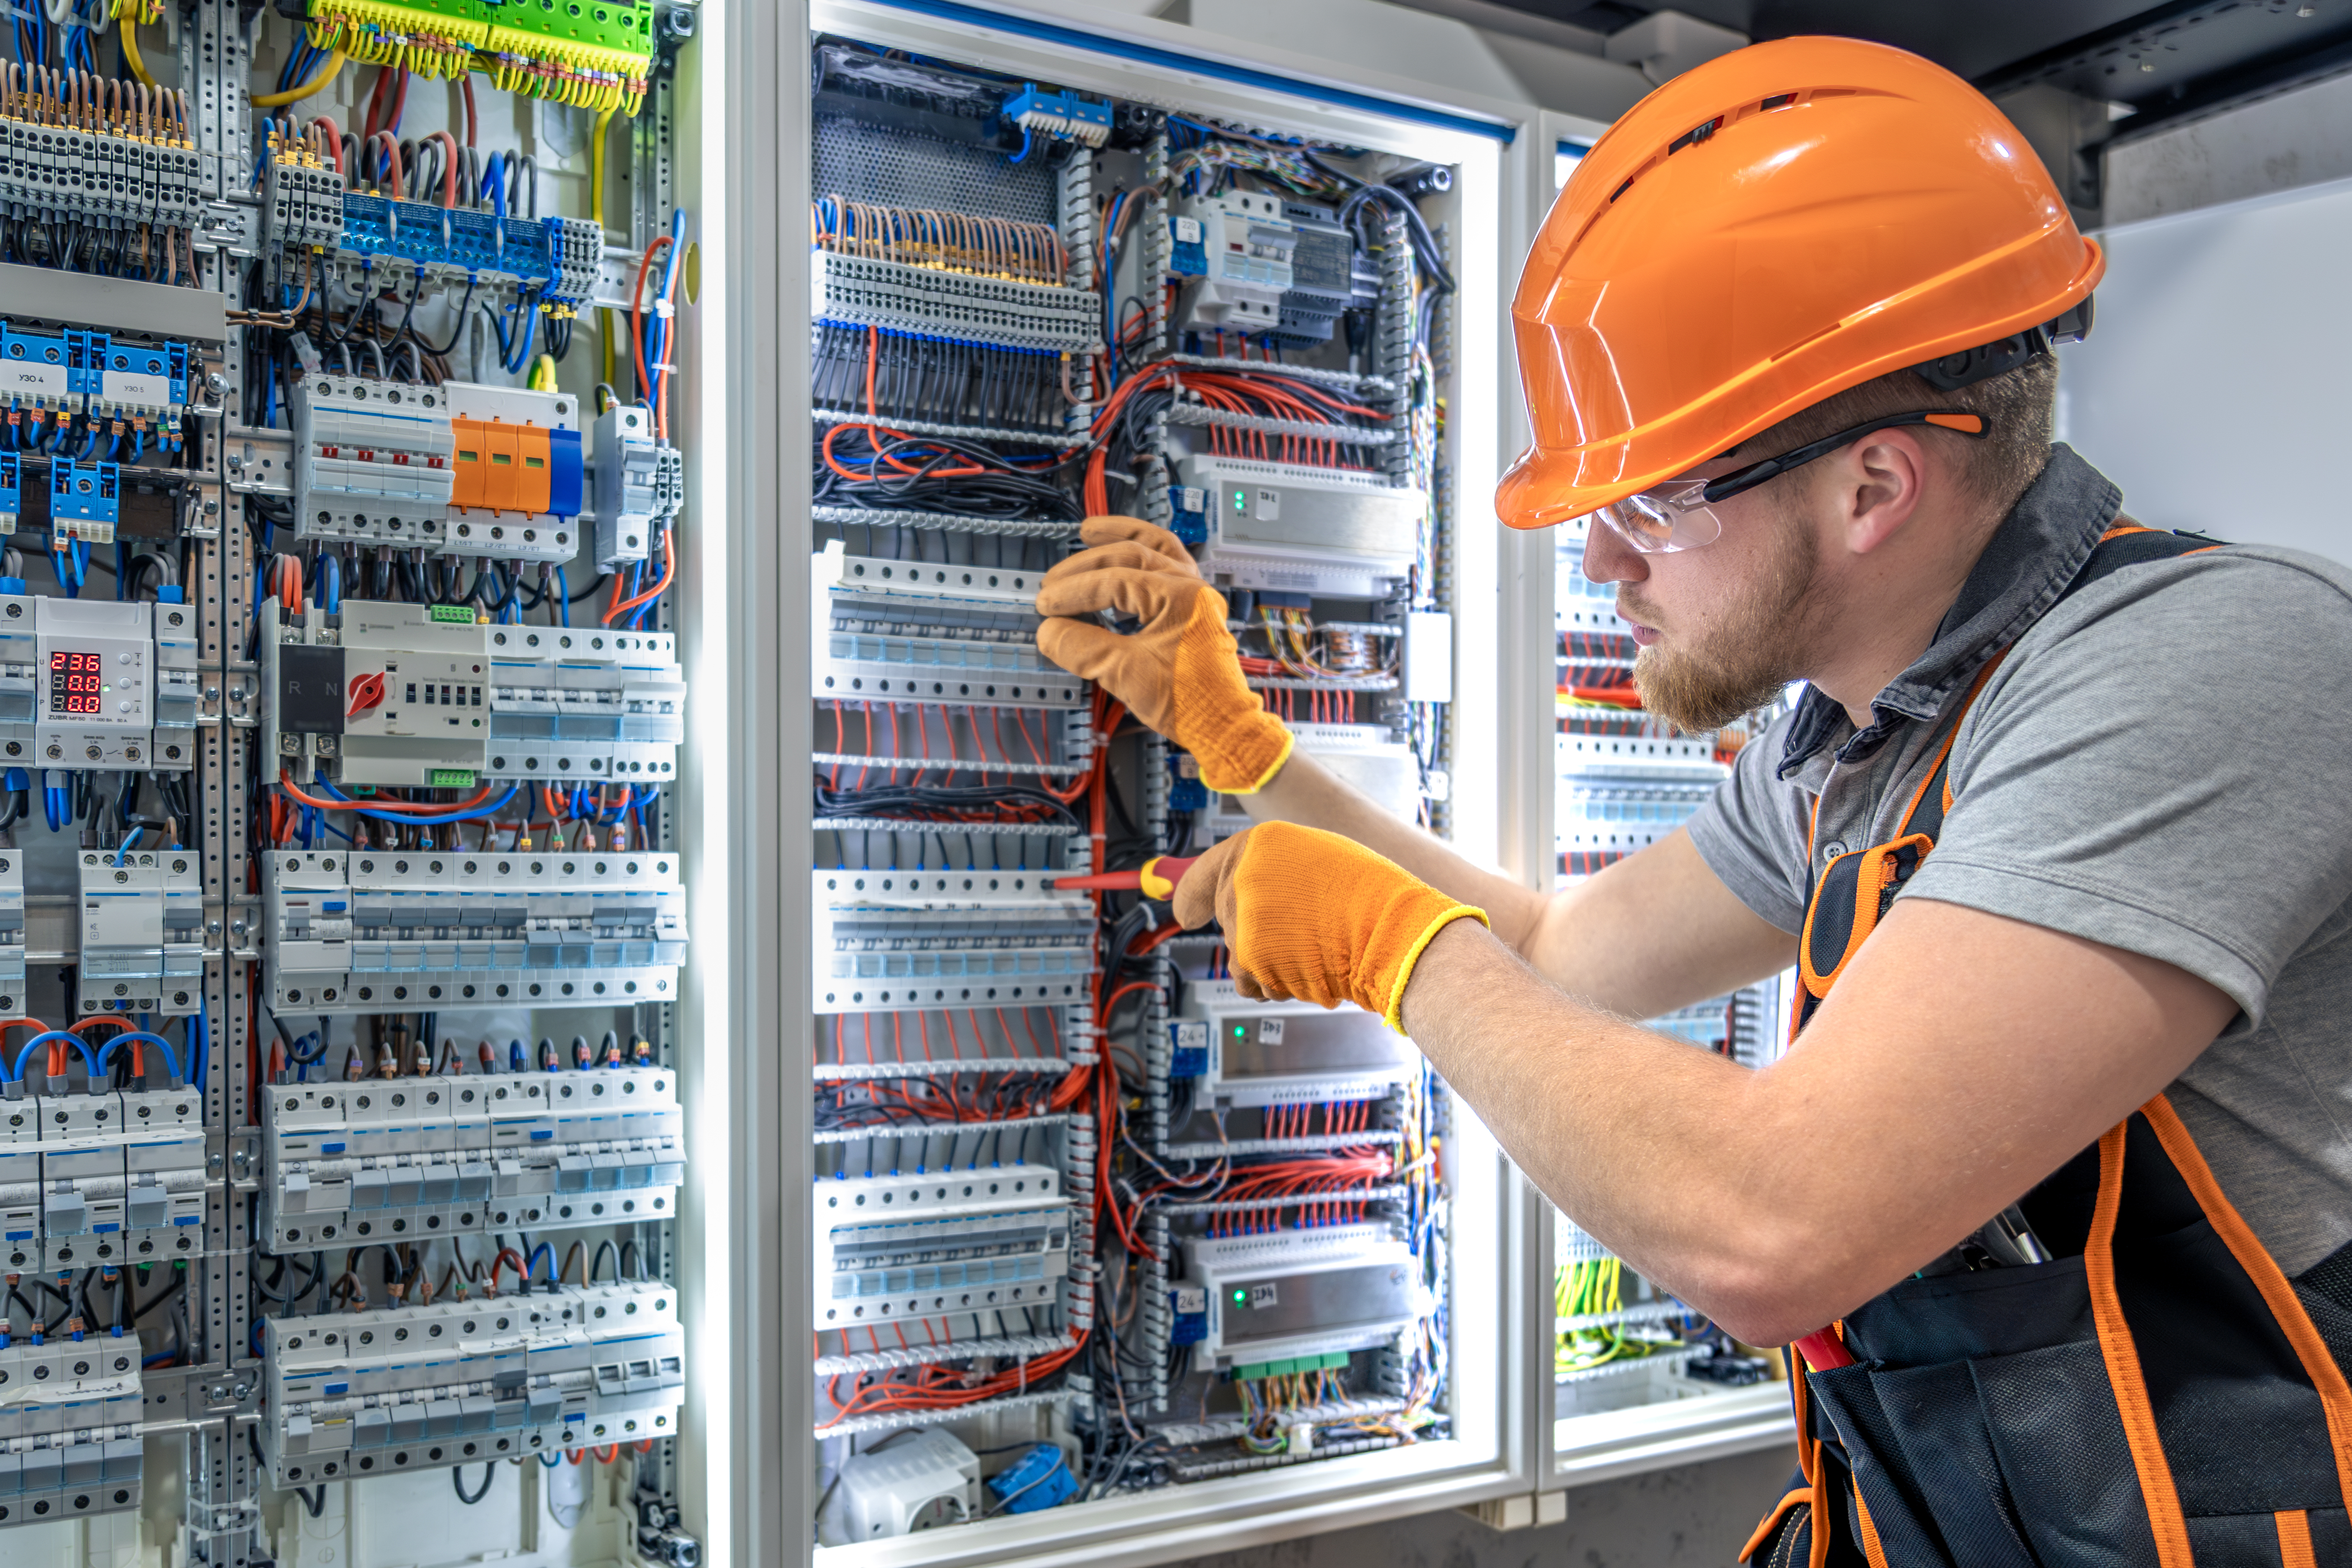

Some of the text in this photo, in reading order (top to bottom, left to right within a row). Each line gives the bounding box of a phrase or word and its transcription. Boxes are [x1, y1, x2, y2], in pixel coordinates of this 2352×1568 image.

[1182, 220, 1196, 231] 220
[1185, 490, 1200, 499] 220
[51, 653, 100, 671] 236
[289, 681, 337, 696] R N
[1179, 1030, 1194, 1043] 24
[1179, 1295, 1194, 1308] 24
